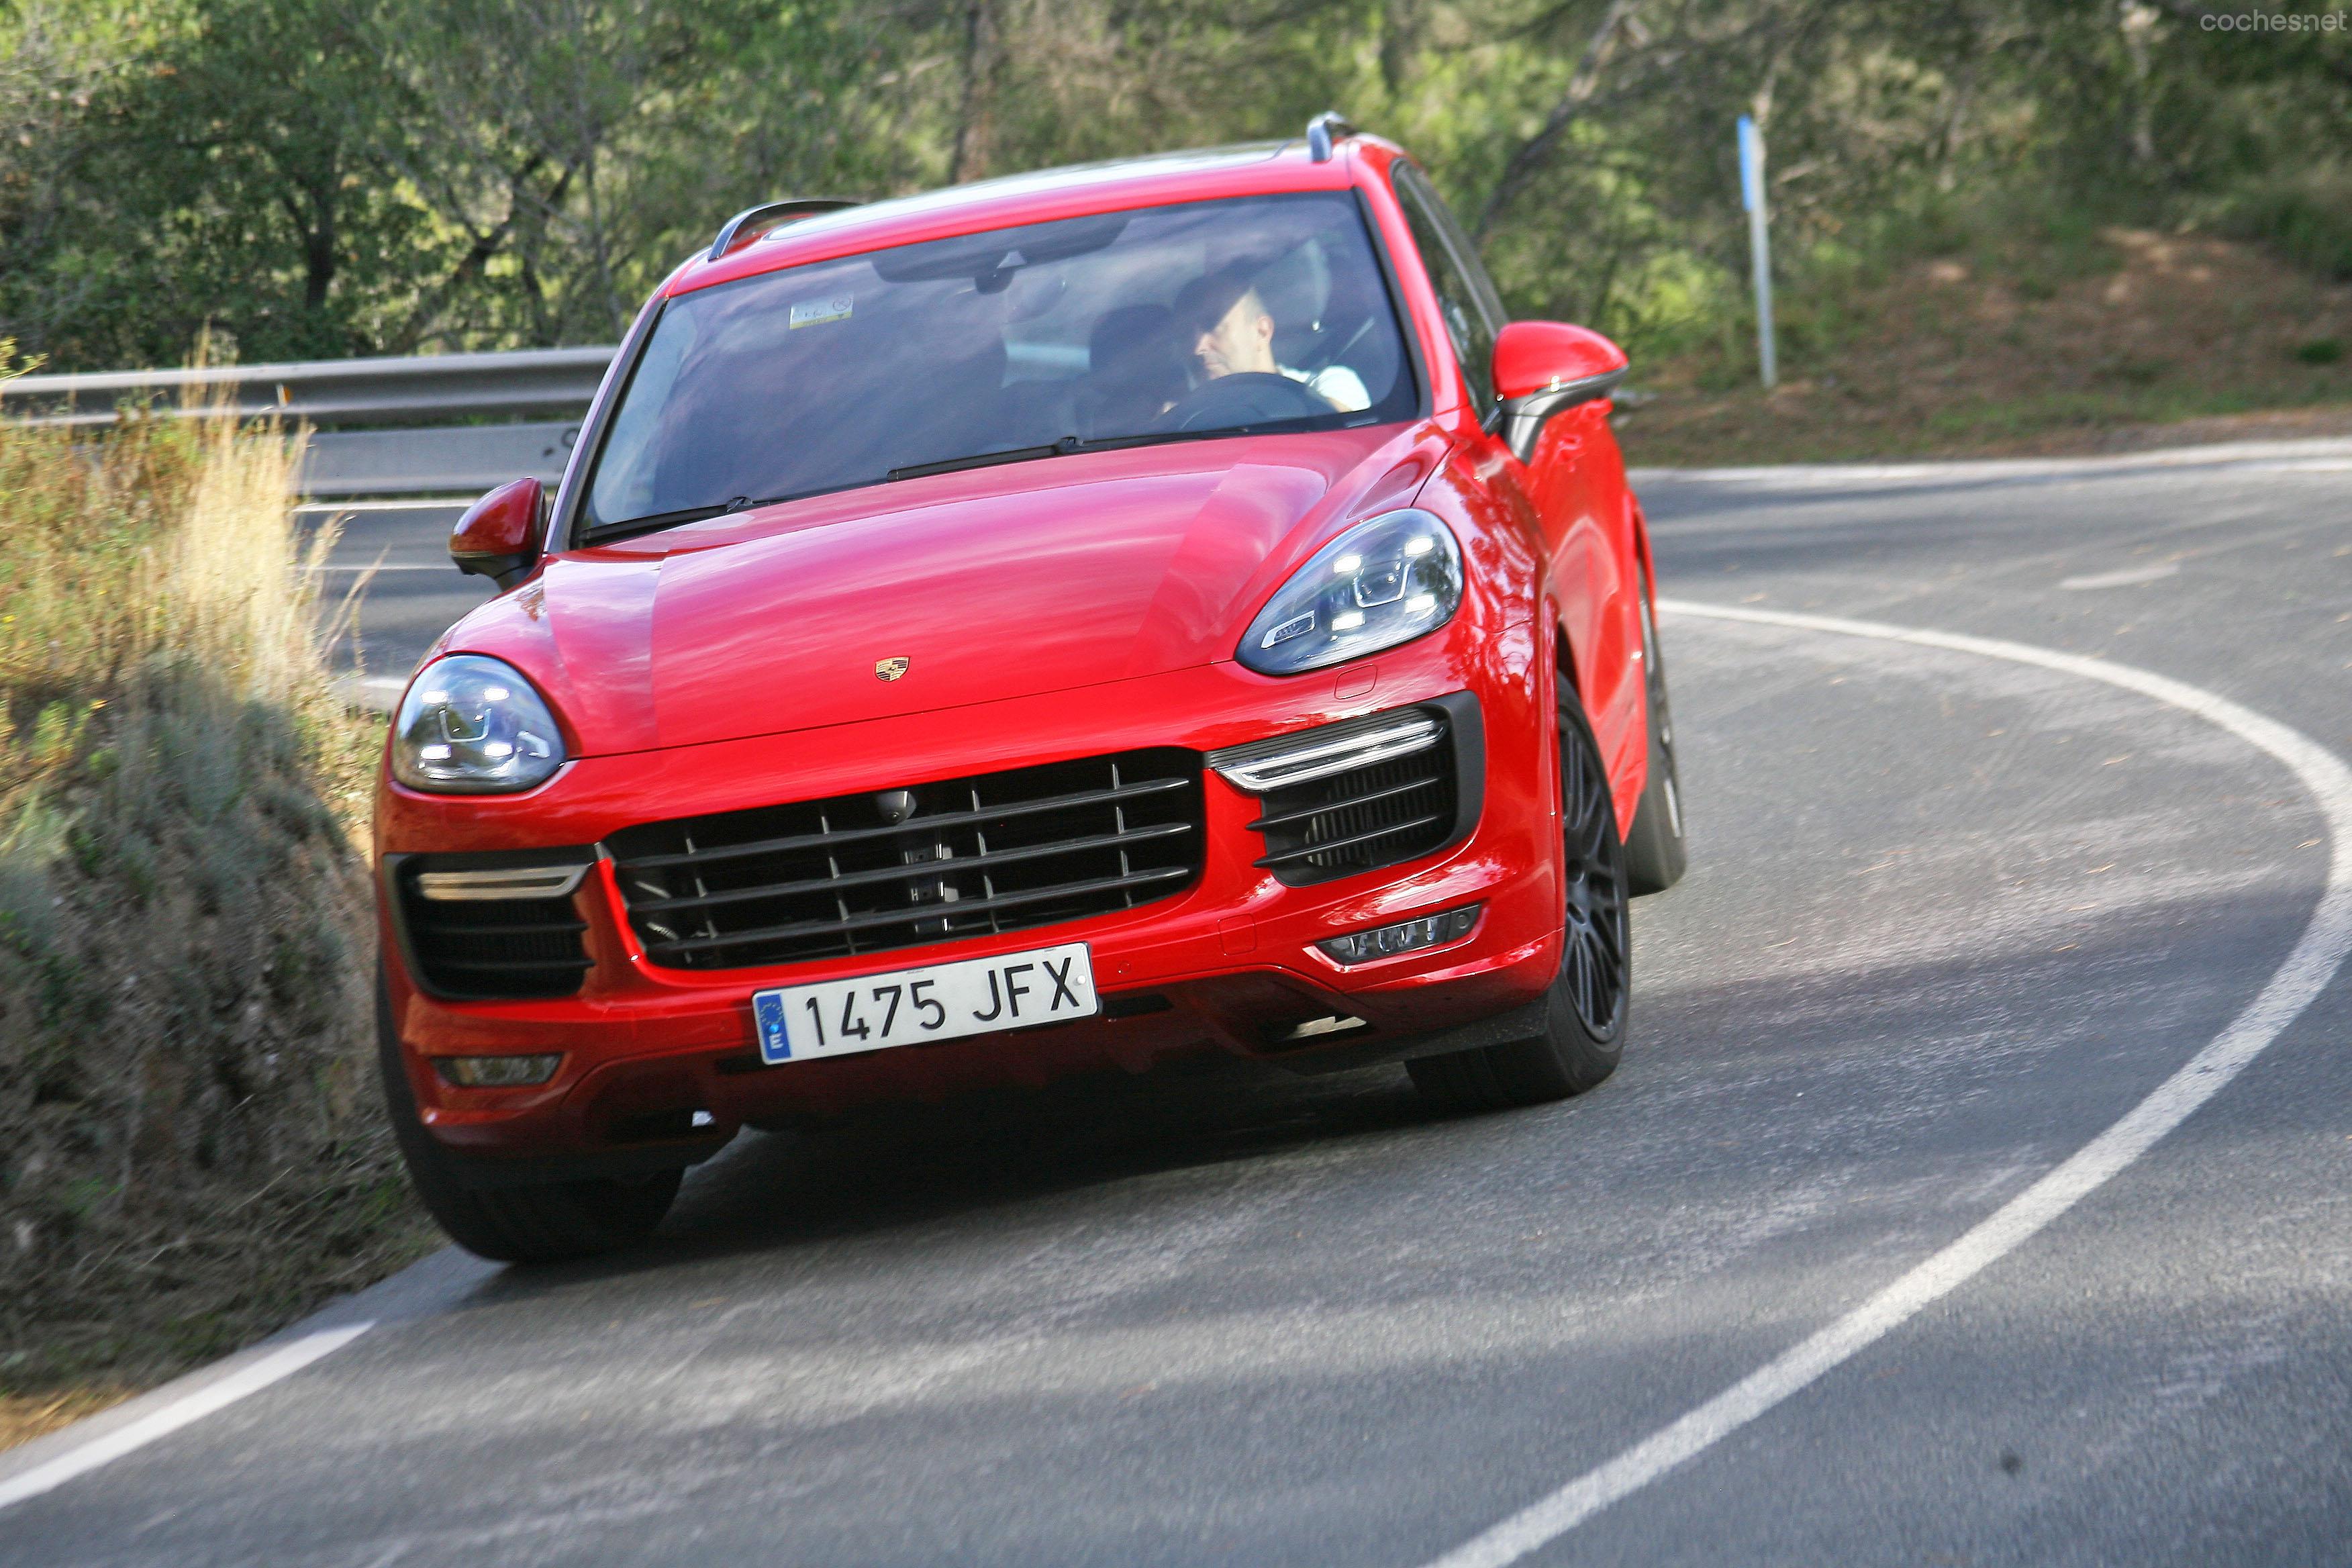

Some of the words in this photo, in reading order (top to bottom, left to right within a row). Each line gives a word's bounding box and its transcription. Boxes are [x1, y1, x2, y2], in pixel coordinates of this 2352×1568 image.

[769, 1033, 784, 1050] E
[805, 979, 946, 1046] 1475
[973, 957, 1080, 1022] JFX
